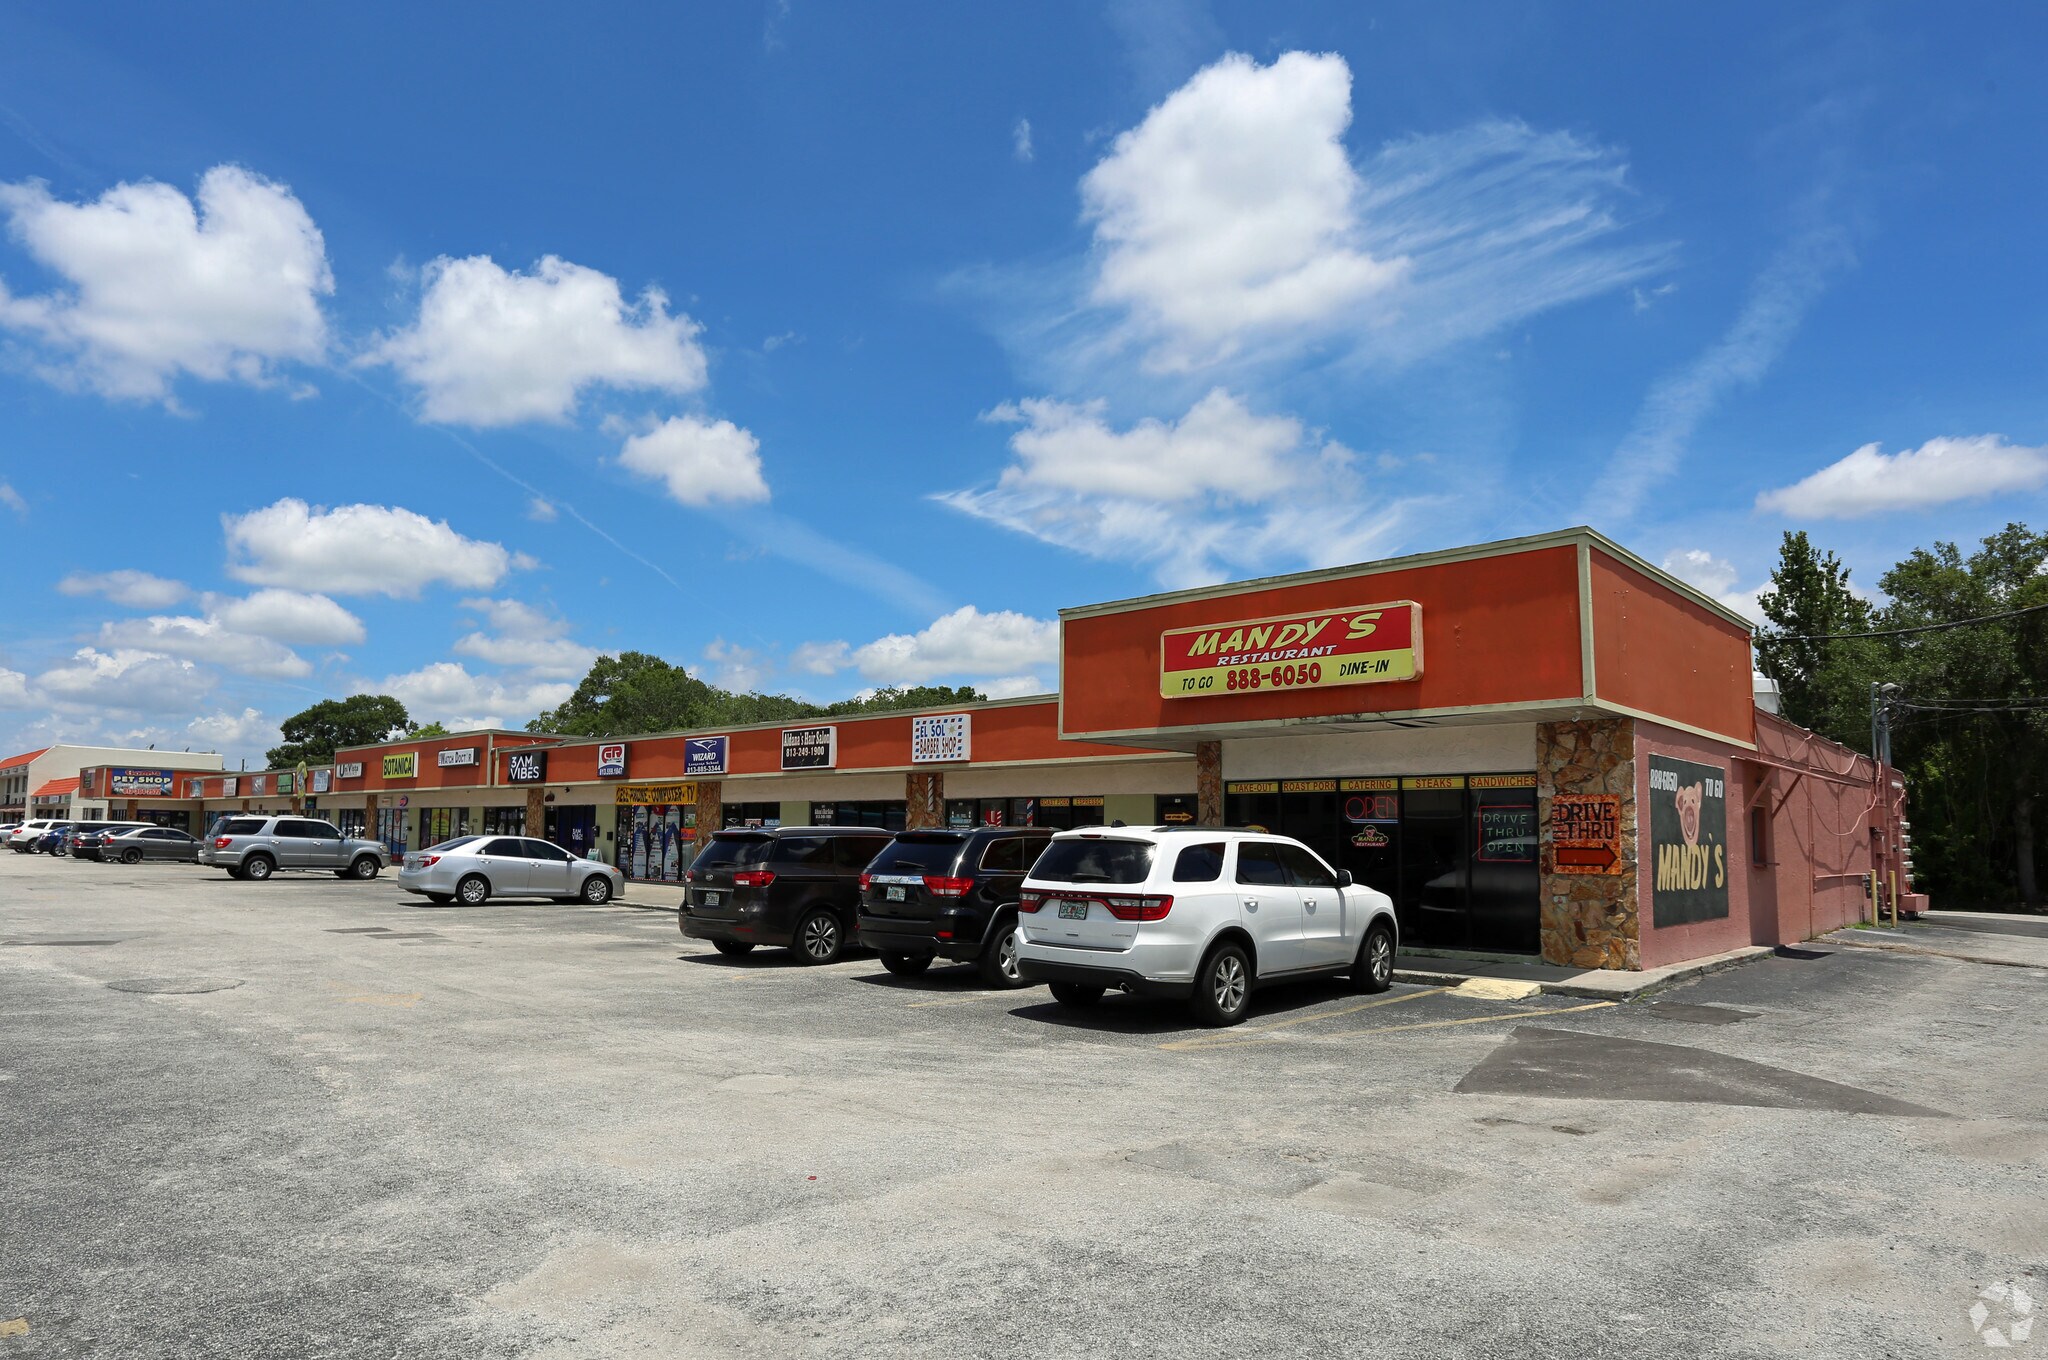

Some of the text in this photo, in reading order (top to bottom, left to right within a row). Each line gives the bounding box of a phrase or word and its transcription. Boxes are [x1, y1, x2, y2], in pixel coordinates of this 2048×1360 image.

[1216, 645, 1338, 666] RESTAURANT
[1182, 659, 1390, 691] TO GO 888-6050 DINE-IN
[920, 724, 945, 738] EL SOL
[804, 731, 815, 745] Hair
[815, 731, 830, 744] Salon
[786, 746, 825, 757] 813-249-1900
[920, 737, 957, 754] BARBER SHOP
[511, 755, 533, 768] 3AM
[692, 752, 717, 761] WIZARD
[383, 757, 412, 776] BOTANICA
[510, 766, 540, 779] VIBES
[113, 775, 171, 784] PET SHOP
[1283, 780, 1336, 791] ROAST PORK
[1348, 780, 1392, 790] CATERING
[1416, 778, 1452, 788] STEAKS
[1470, 776, 1537, 787] SANDWICHES
[1650, 768, 1724, 798] 888-6050 TO GO
[616, 785, 695, 802] CELL PHONE COMPUTER TV
[1235, 783, 1273, 792] TAKE-OUT
[1345, 796, 1398, 819] OPEN
[1557, 802, 1615, 821] DRIVE
[1482, 813, 1528, 825] DRIVE
[1486, 827, 1526, 837] THRU
[1566, 820, 1615, 840] THRU
[1487, 842, 1525, 852] OPEN
